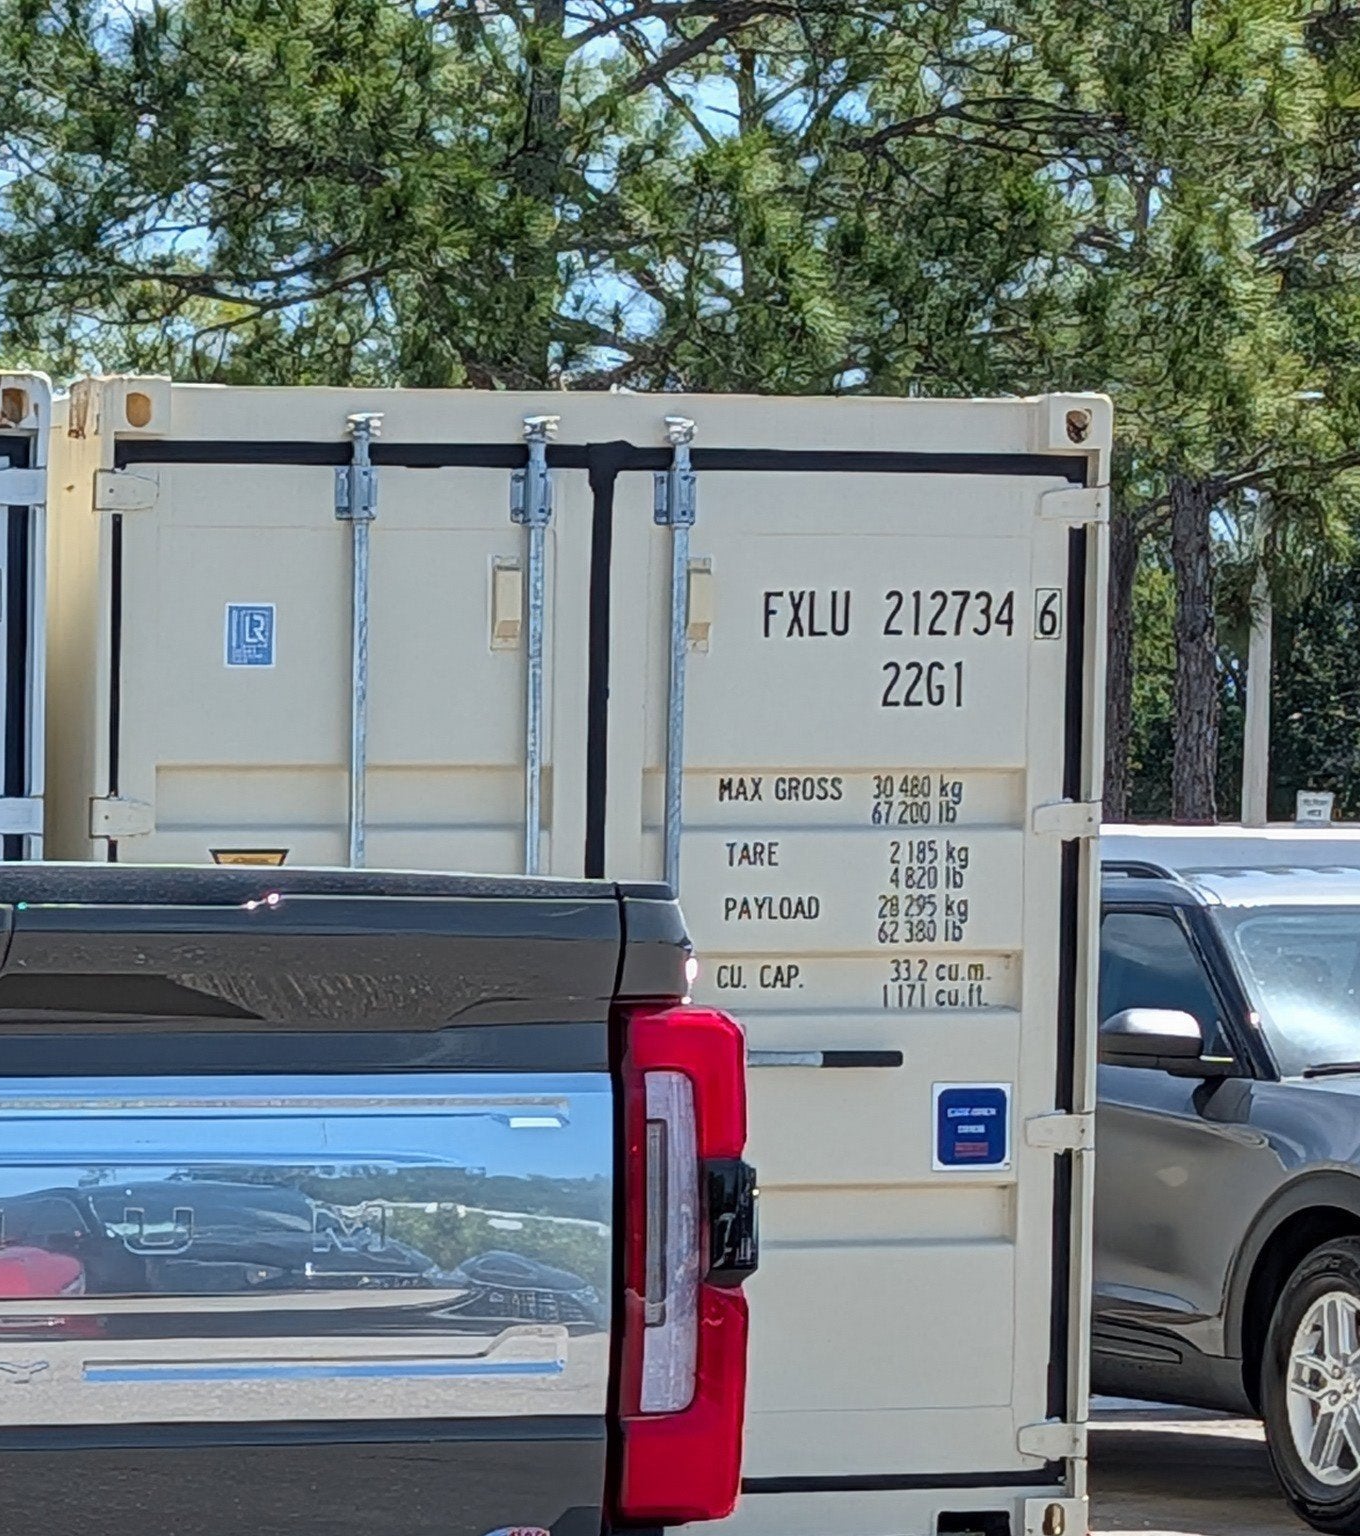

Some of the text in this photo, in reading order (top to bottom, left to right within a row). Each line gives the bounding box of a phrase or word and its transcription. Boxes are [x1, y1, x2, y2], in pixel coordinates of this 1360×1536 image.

[762, 590, 1058, 638] FXLU 212734 6
[881, 661, 963, 707] 22G1
[718, 776, 843, 801] MAX GROSS
[940, 774, 963, 805] kg
[939, 800, 958, 825] lb
[726, 842, 780, 867] TARE
[946, 840, 970, 870] kg
[945, 865, 964, 889] lb
[724, 897, 821, 920] PAYLOAD
[944, 894, 969, 924] kg
[944, 919, 964, 942] lb
[716, 965, 805, 989] CU. CAP.
